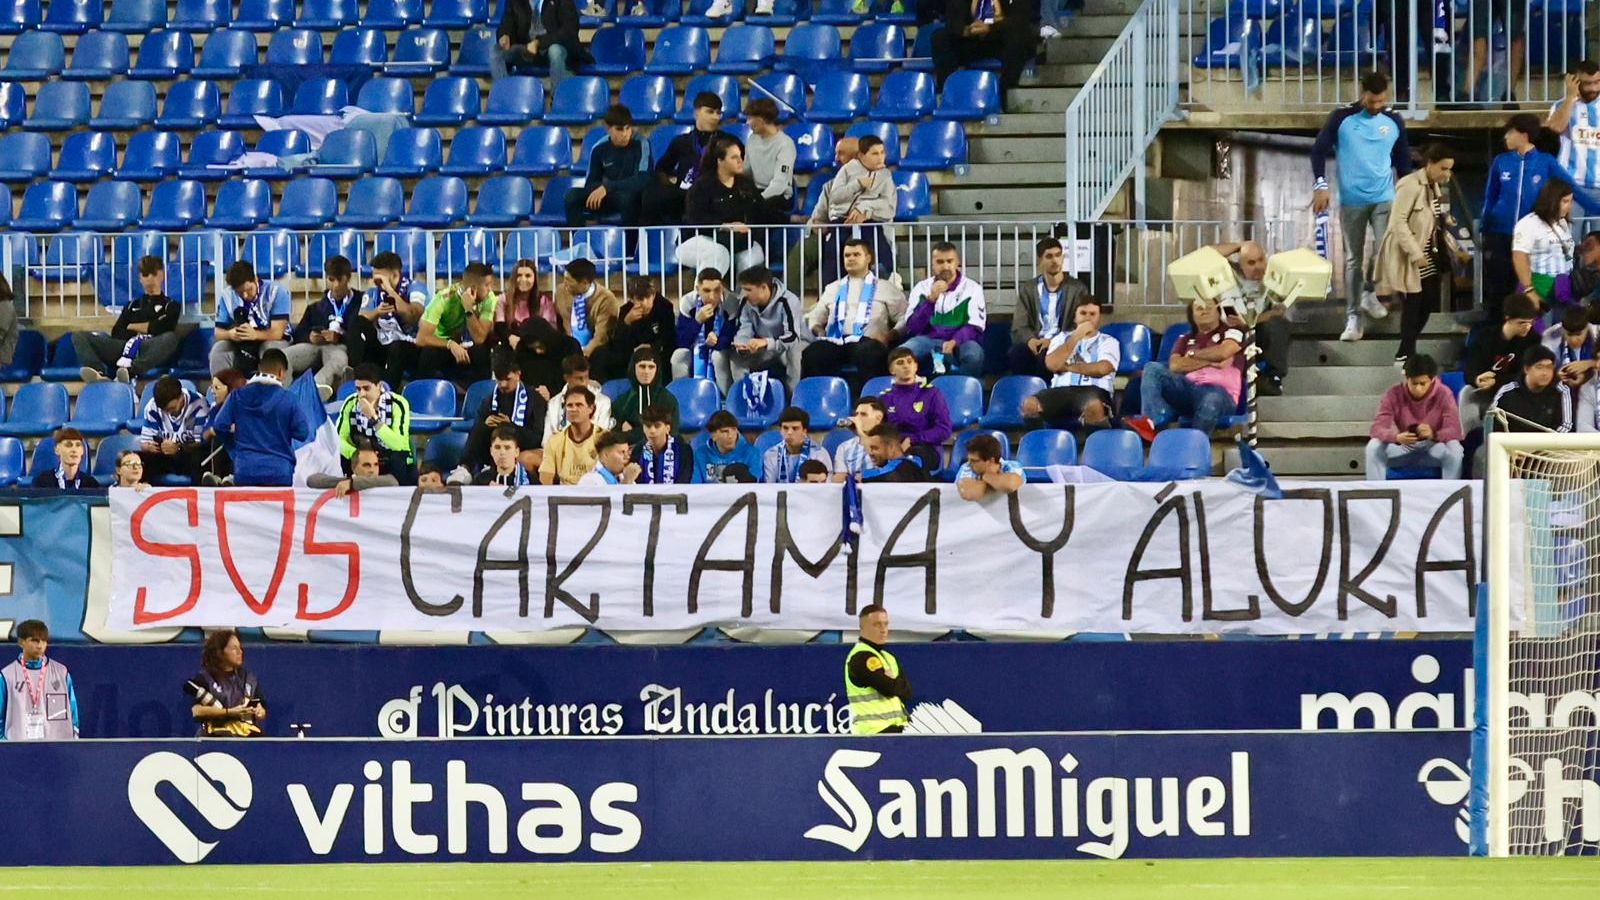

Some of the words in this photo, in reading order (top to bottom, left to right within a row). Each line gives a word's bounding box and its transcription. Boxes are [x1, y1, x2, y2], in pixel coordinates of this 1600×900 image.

[130, 487, 361, 624] SOS
[1008, 485, 1075, 619] Y
[1122, 481, 1479, 623] ÁLORA
[431, 681, 624, 737] Pinturas
[639, 683, 854, 735] Andalucía
[286, 759, 642, 856] vithas
